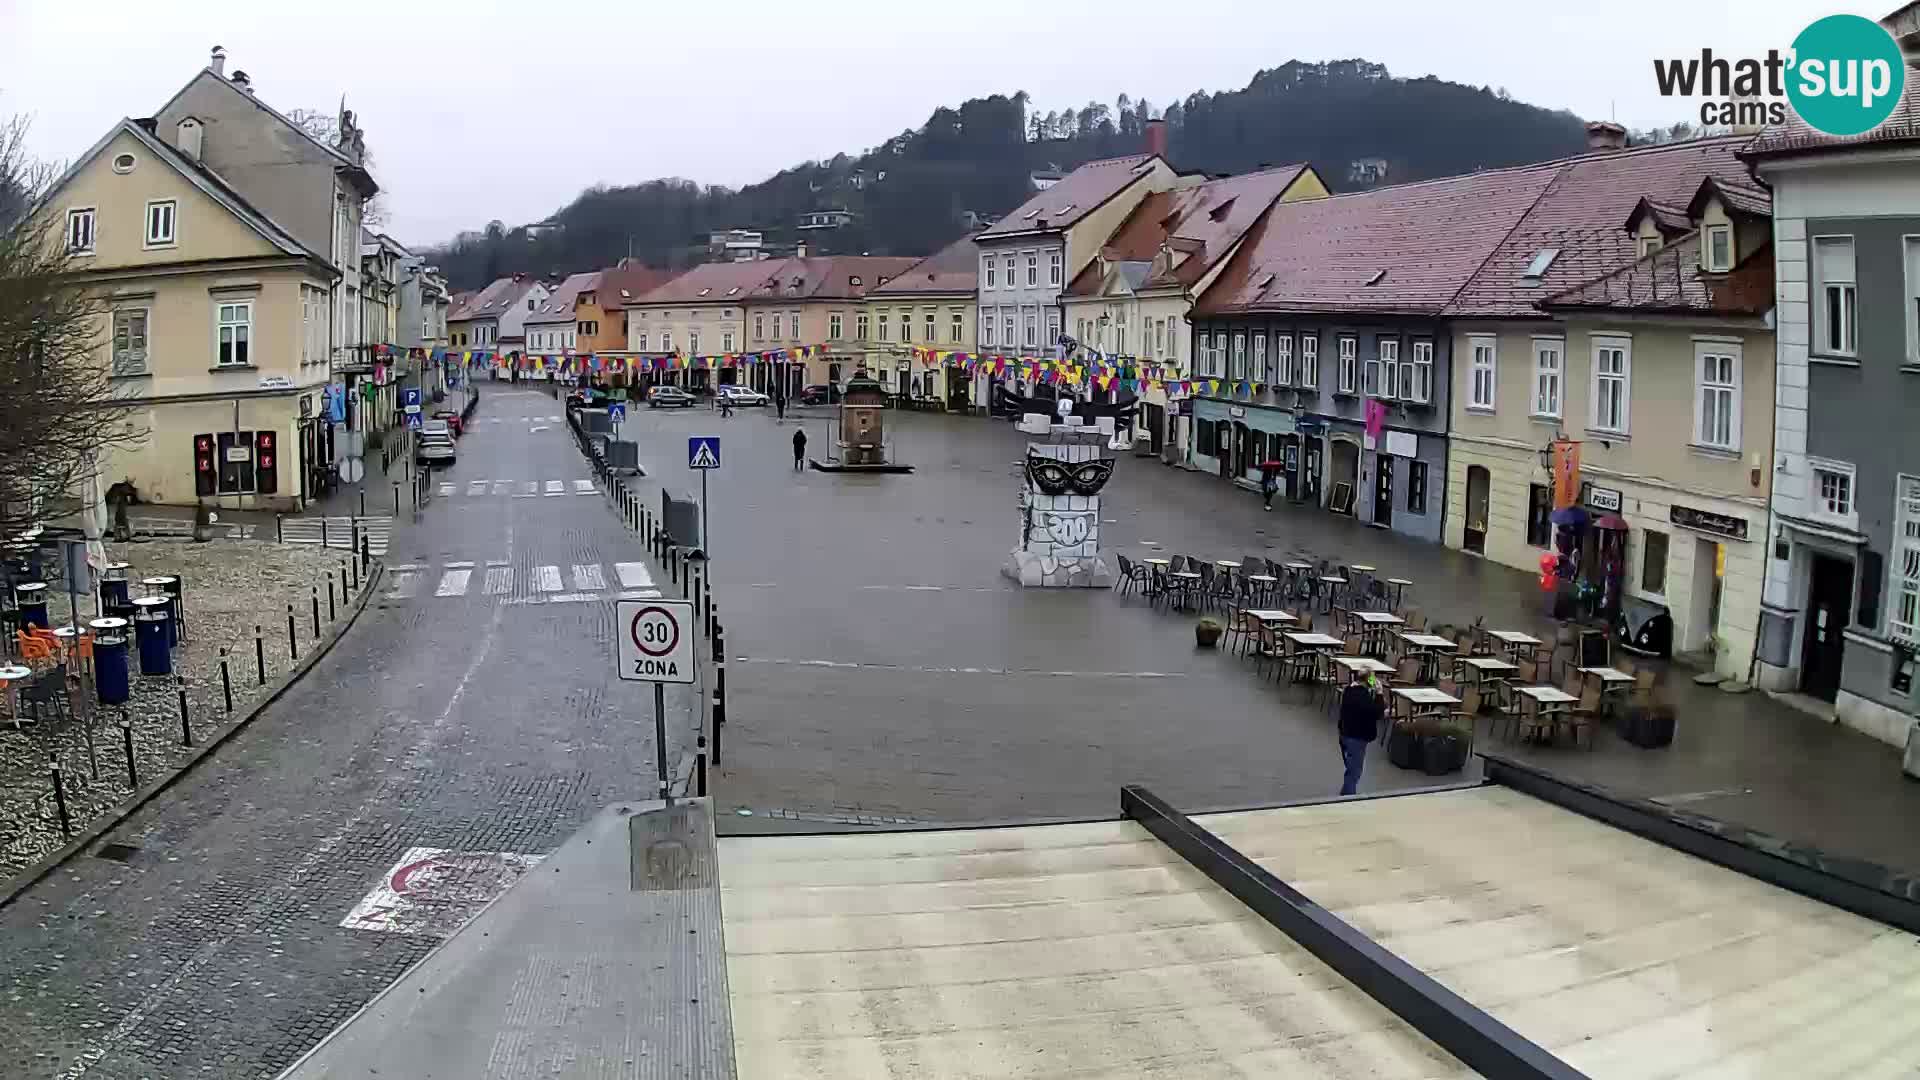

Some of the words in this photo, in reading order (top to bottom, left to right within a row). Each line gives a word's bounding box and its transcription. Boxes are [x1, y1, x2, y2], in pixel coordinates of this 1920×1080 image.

[408, 391, 417, 403] P
[1048, 515, 1087, 546] 200
[643, 622, 668, 644] 30
[634, 659, 678, 677] ZONA
